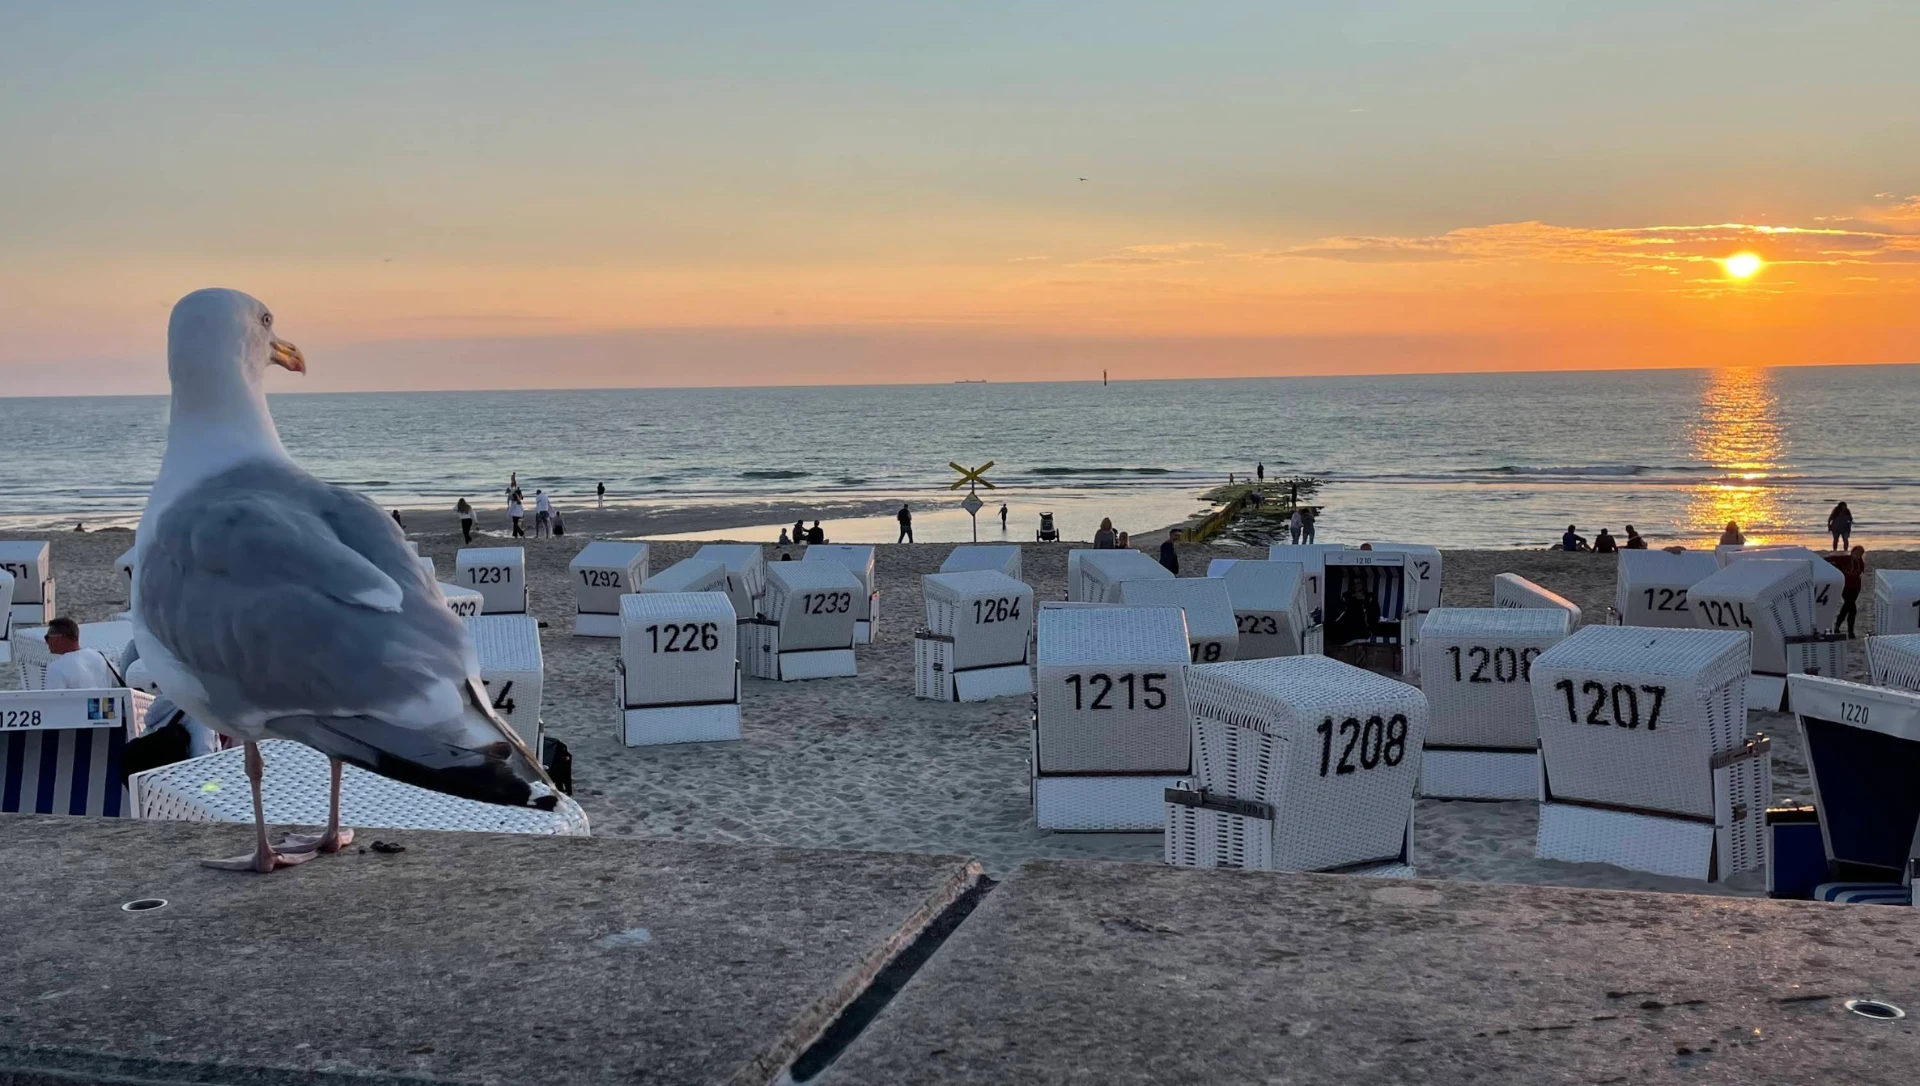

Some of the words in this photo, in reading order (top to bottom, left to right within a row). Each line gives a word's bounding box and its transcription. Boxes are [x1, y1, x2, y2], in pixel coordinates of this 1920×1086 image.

[0, 563, 27, 579] 51
[468, 567, 512, 584] 1231
[580, 570, 621, 588] 1292
[803, 593, 850, 614] 1233
[973, 597, 1020, 624] 1264
[1644, 588, 1688, 611] 122
[1699, 601, 1752, 628] 1214
[646, 622, 718, 653] 1226
[1065, 673, 1166, 710] 1215
[1556, 679, 1666, 730] 1207
[1841, 702, 1869, 724] 1220
[1317, 714, 1408, 777] 1208
